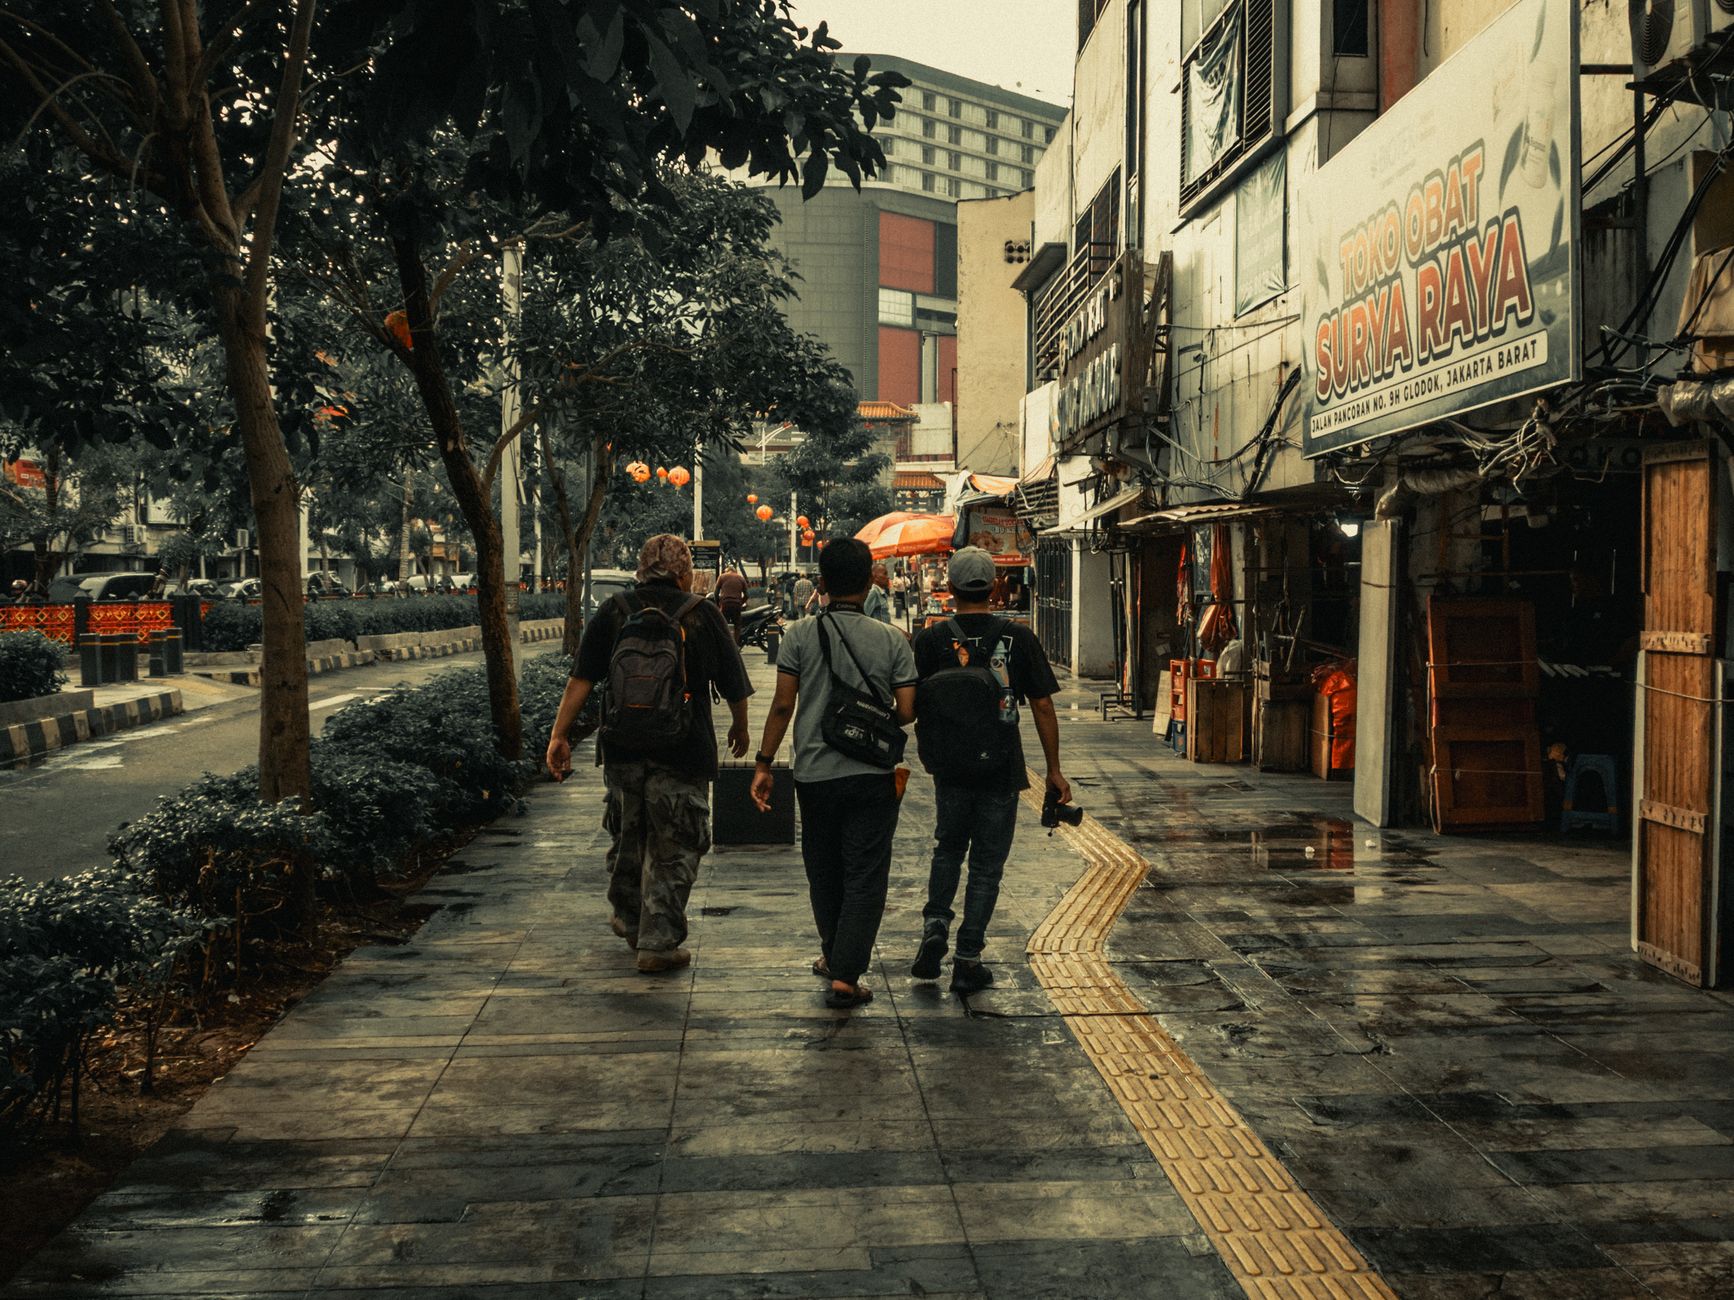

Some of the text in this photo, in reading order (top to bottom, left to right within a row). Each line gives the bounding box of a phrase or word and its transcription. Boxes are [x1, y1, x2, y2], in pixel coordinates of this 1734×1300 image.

[1339, 202, 1401, 299] TOKO
[1404, 142, 1484, 263] OBAT
[1316, 276, 1412, 401] SURYA
[1417, 213, 1533, 357] RAYA
[1312, 339, 1537, 433] JALAN PANCORAN NO. 9H GLODOK, JAKARTA BARAT
